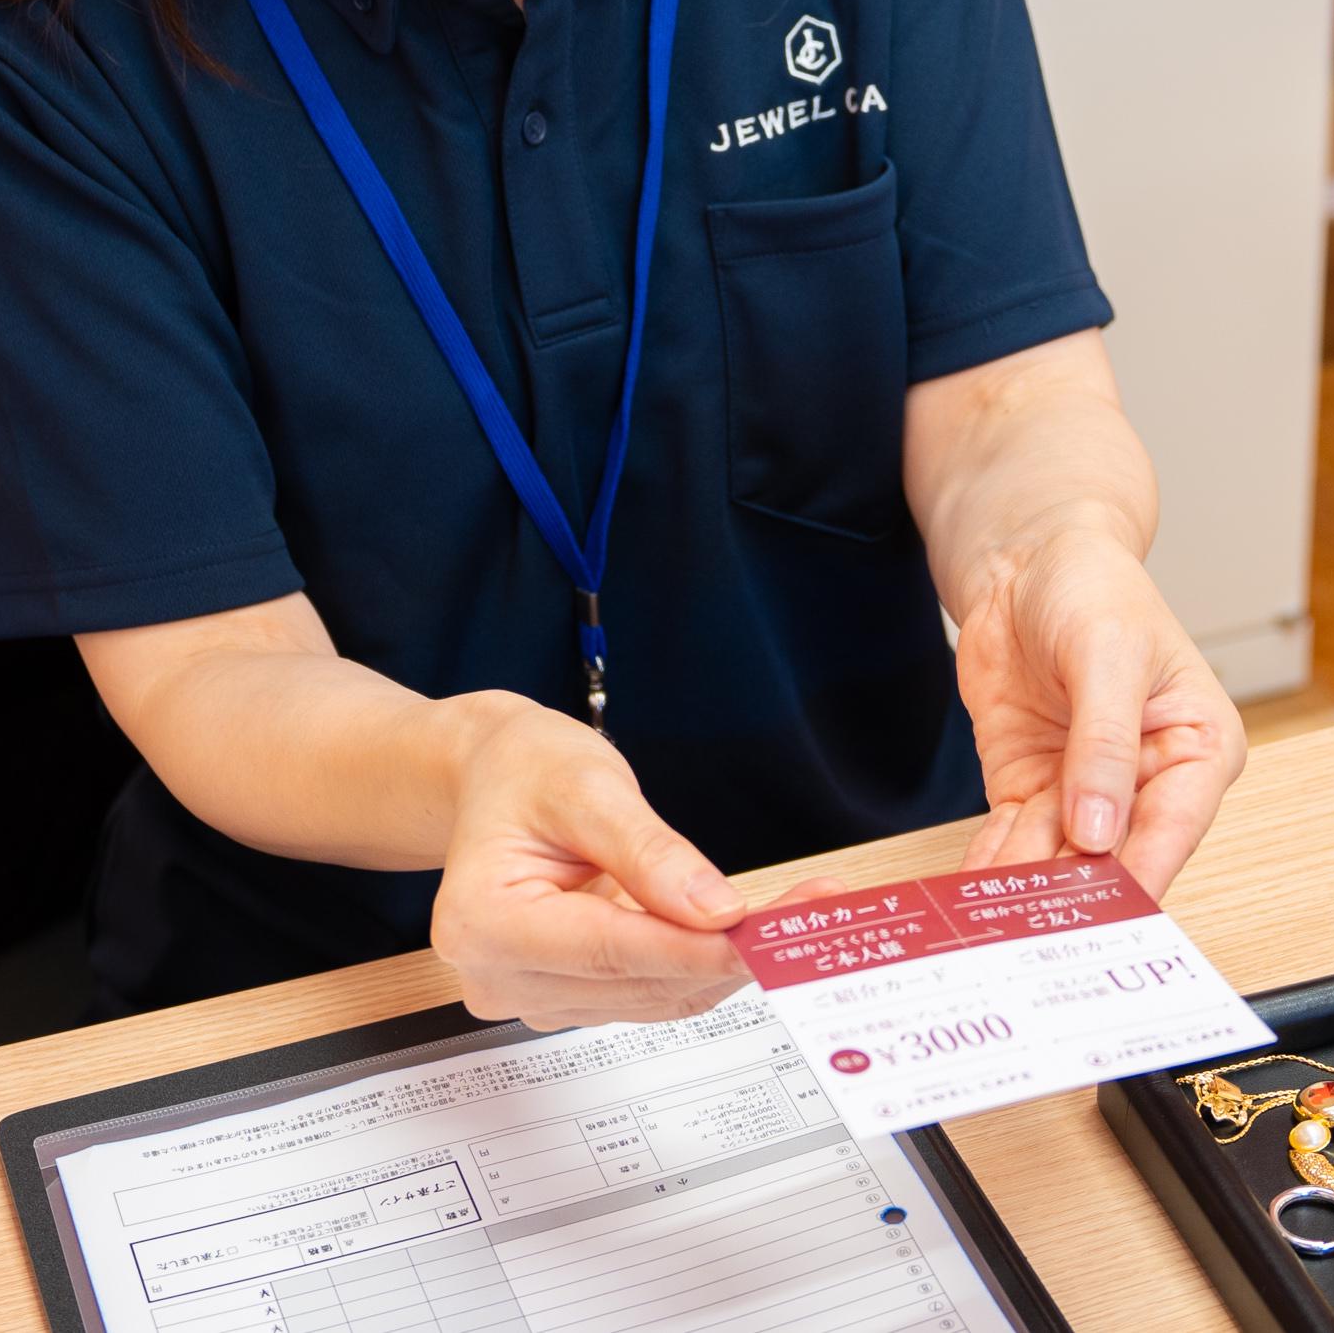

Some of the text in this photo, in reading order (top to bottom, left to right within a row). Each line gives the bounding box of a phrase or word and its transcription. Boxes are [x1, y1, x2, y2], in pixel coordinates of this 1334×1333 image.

[710, 95, 836, 152] JEWEL
[959, 864, 1092, 898] ご紹介カード
[758, 895, 899, 939] ご紹介カード
[1027, 907, 1093, 930] ご友人
[815, 940, 907, 971] ご本人様
[1107, 955, 1196, 991] UP!
[875, 1013, 1013, 1066] ¥3000
[478, 1114, 628, 1156] 合計価格 円
[488, 1170, 499, 1179] 円
[499, 1161, 641, 1204] 点数 点
[378, 1179, 456, 1207] ご了承サイン
[444, 1207, 470, 1220] 点数
[150, 1243, 333, 1293] 価格 円
[156, 1248, 224, 1271] 了承しました
